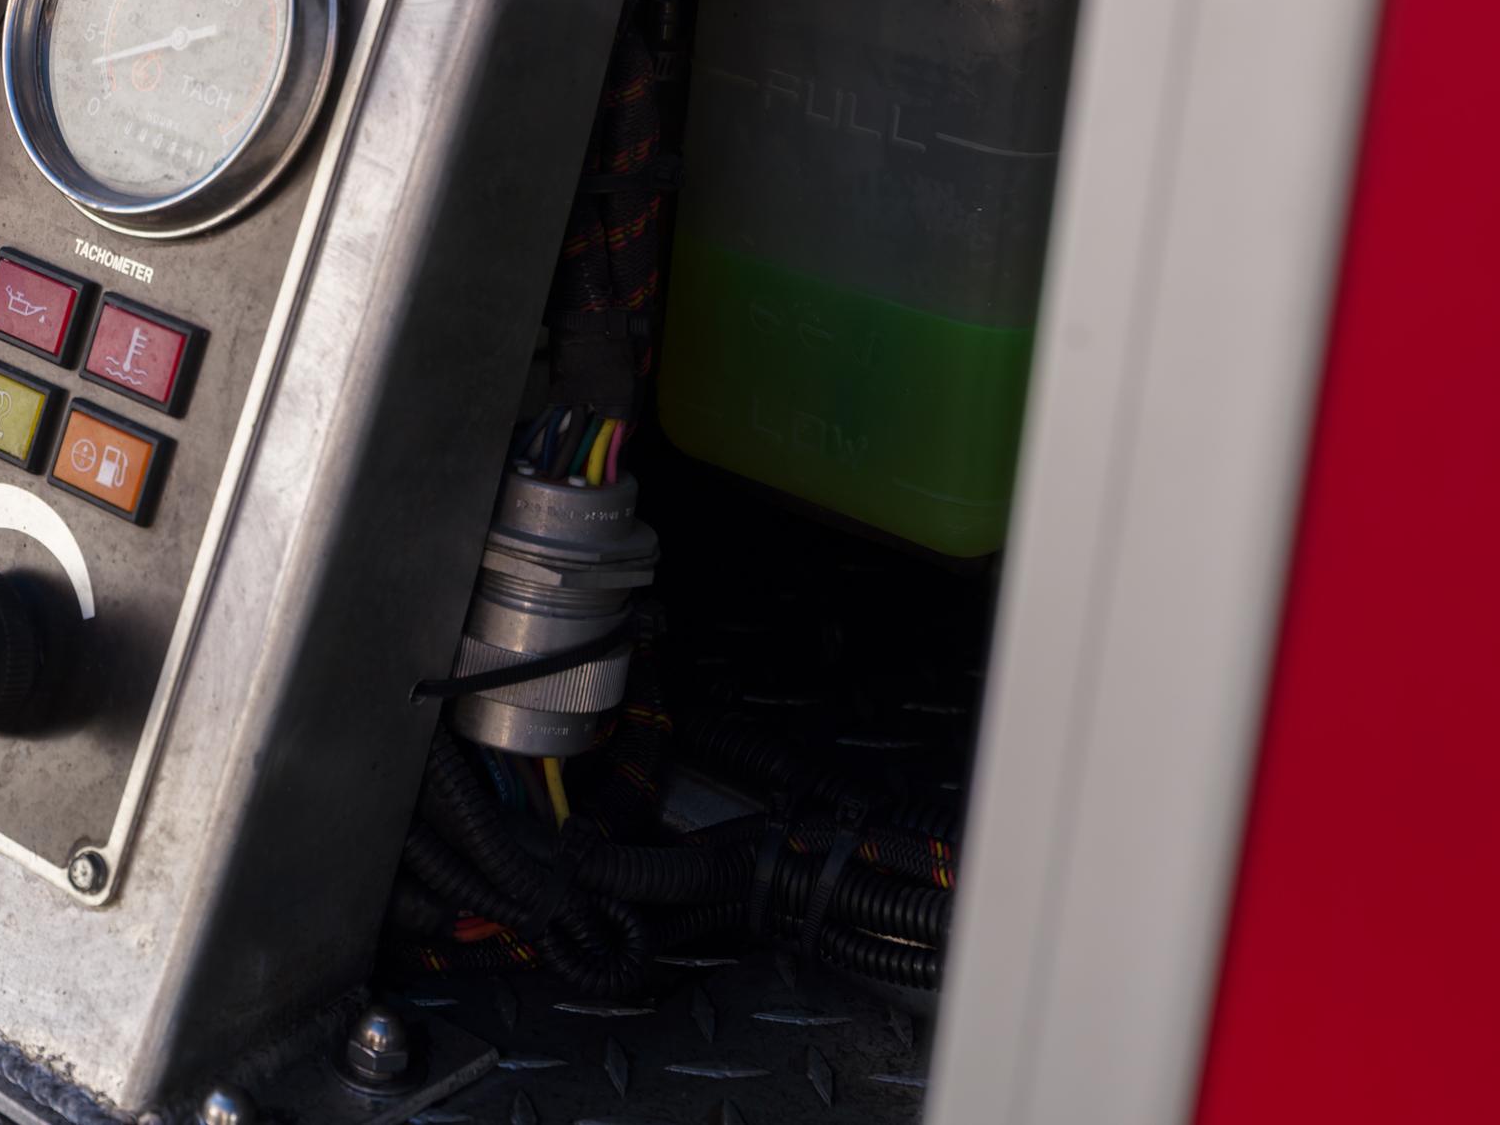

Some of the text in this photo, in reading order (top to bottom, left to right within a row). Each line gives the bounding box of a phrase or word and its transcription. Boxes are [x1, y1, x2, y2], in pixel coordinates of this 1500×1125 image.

[84, 23, 98, 42] 5
[87, 97, 100, 116] 0
[181, 75, 232, 111] TACH
[74, 238, 154, 284] TACHOMETER
